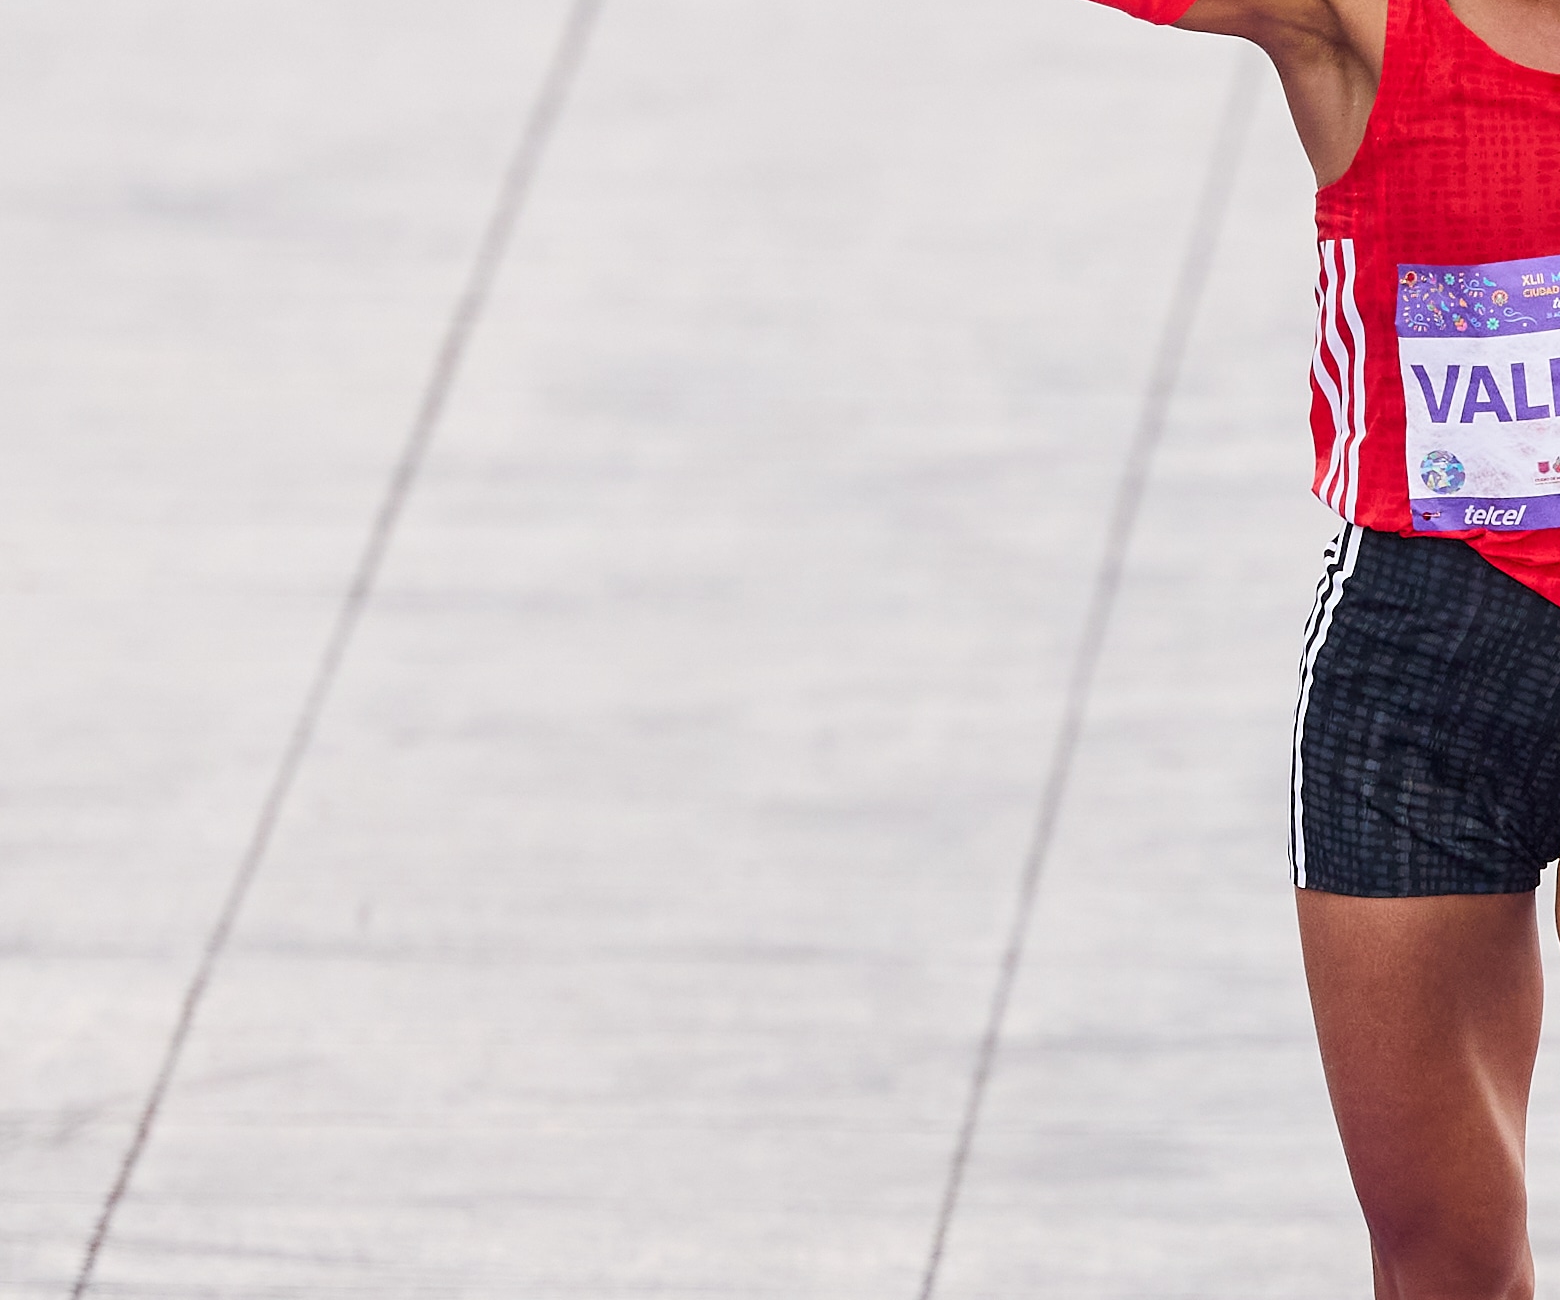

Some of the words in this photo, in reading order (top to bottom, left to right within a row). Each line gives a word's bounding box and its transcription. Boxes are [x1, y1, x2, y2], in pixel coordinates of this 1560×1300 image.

[1521, 273, 1544, 286] XLII
[1523, 285, 1560, 298] CIUDAD
[1464, 504, 1527, 526] telcel
